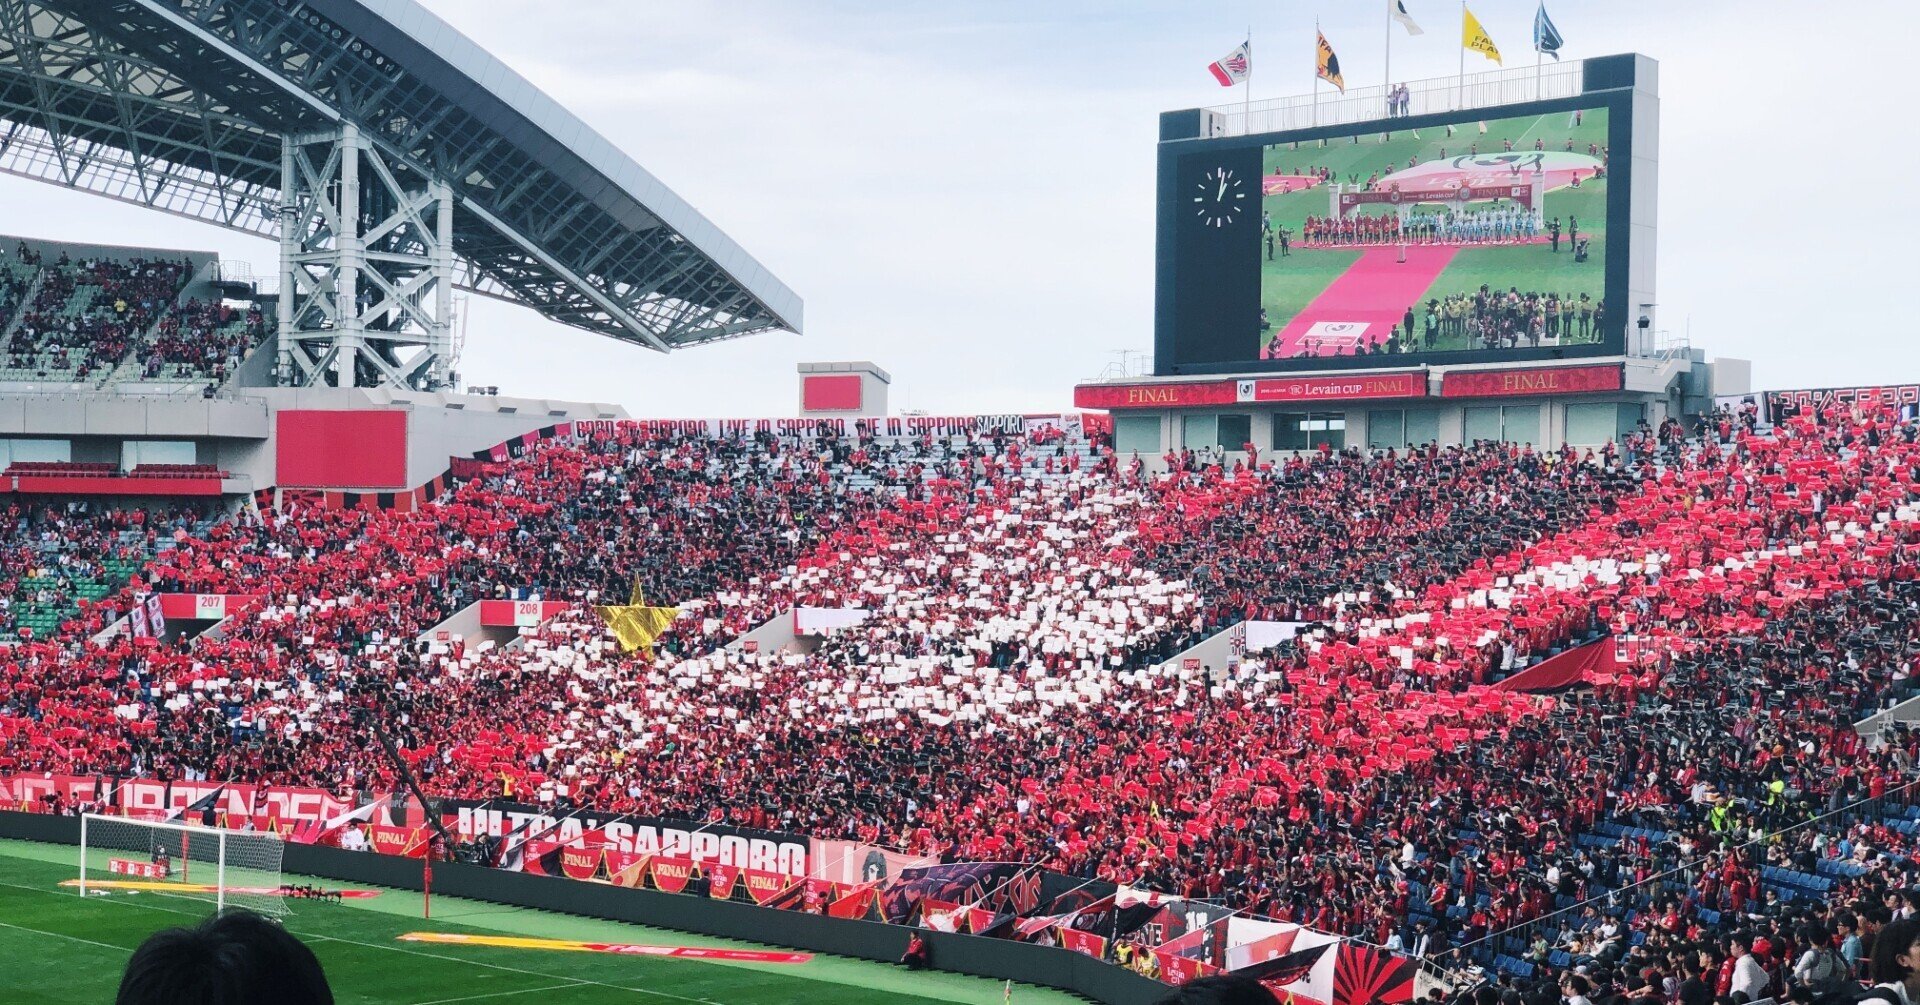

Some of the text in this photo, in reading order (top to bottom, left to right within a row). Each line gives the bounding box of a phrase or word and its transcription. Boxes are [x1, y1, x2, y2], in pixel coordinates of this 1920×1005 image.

[1305, 382, 1341, 395] Levain
[1342, 384, 1363, 394] CUP
[1366, 380, 1406, 393] FINAL
[1503, 373, 1558, 391] FINAL
[1128, 388, 1178, 403] FINAL
[976, 414, 1025, 436] SAPPORO
[201, 596, 220, 608] 207
[519, 603, 538, 615] 208
[376, 831, 406, 845] FINAL
[563, 852, 595, 868] FINAL
[655, 862, 689, 879] FINAL
[749, 875, 779, 891] FINAL
